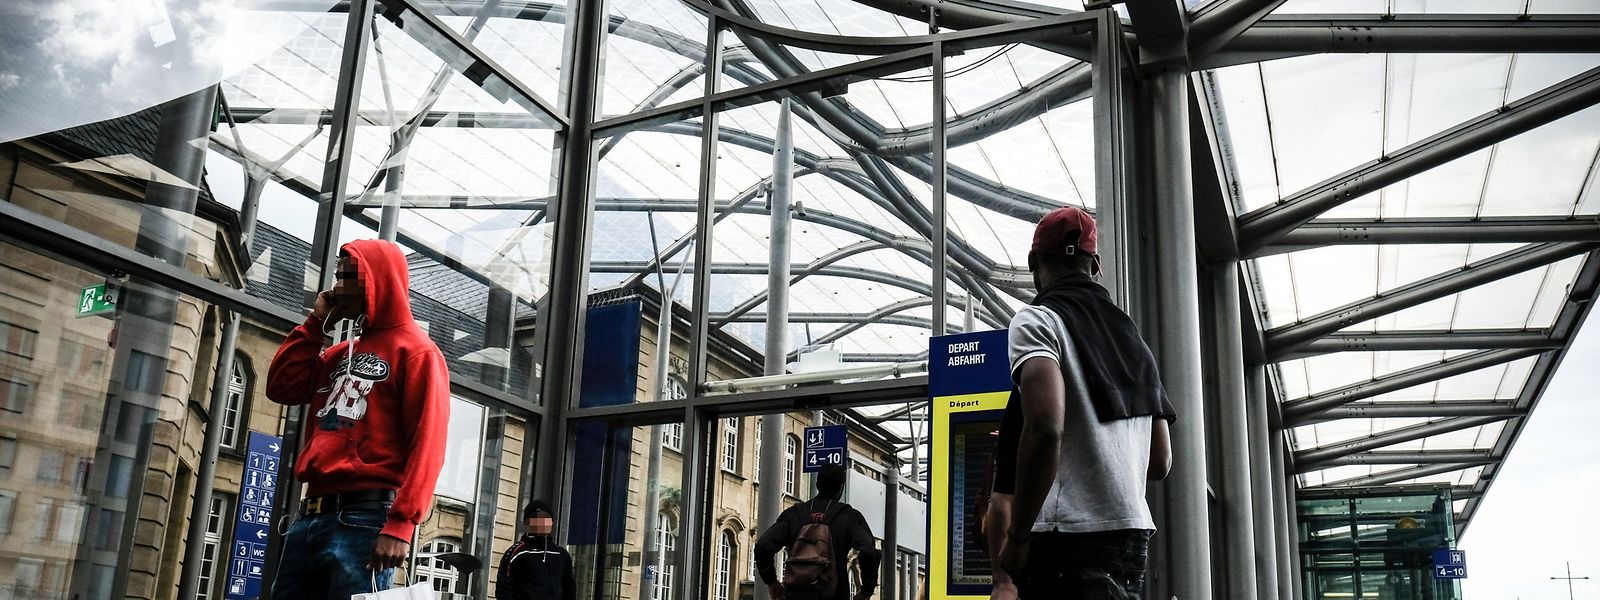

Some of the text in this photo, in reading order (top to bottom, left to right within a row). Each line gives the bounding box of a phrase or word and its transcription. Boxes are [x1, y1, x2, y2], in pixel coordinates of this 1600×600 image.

[948, 341, 980, 354] DEPART
[948, 353, 986, 367] ABFAHRT
[949, 400, 980, 408] Départ
[253, 457, 275, 471] 1 2
[239, 546, 265, 557] 3 WC
